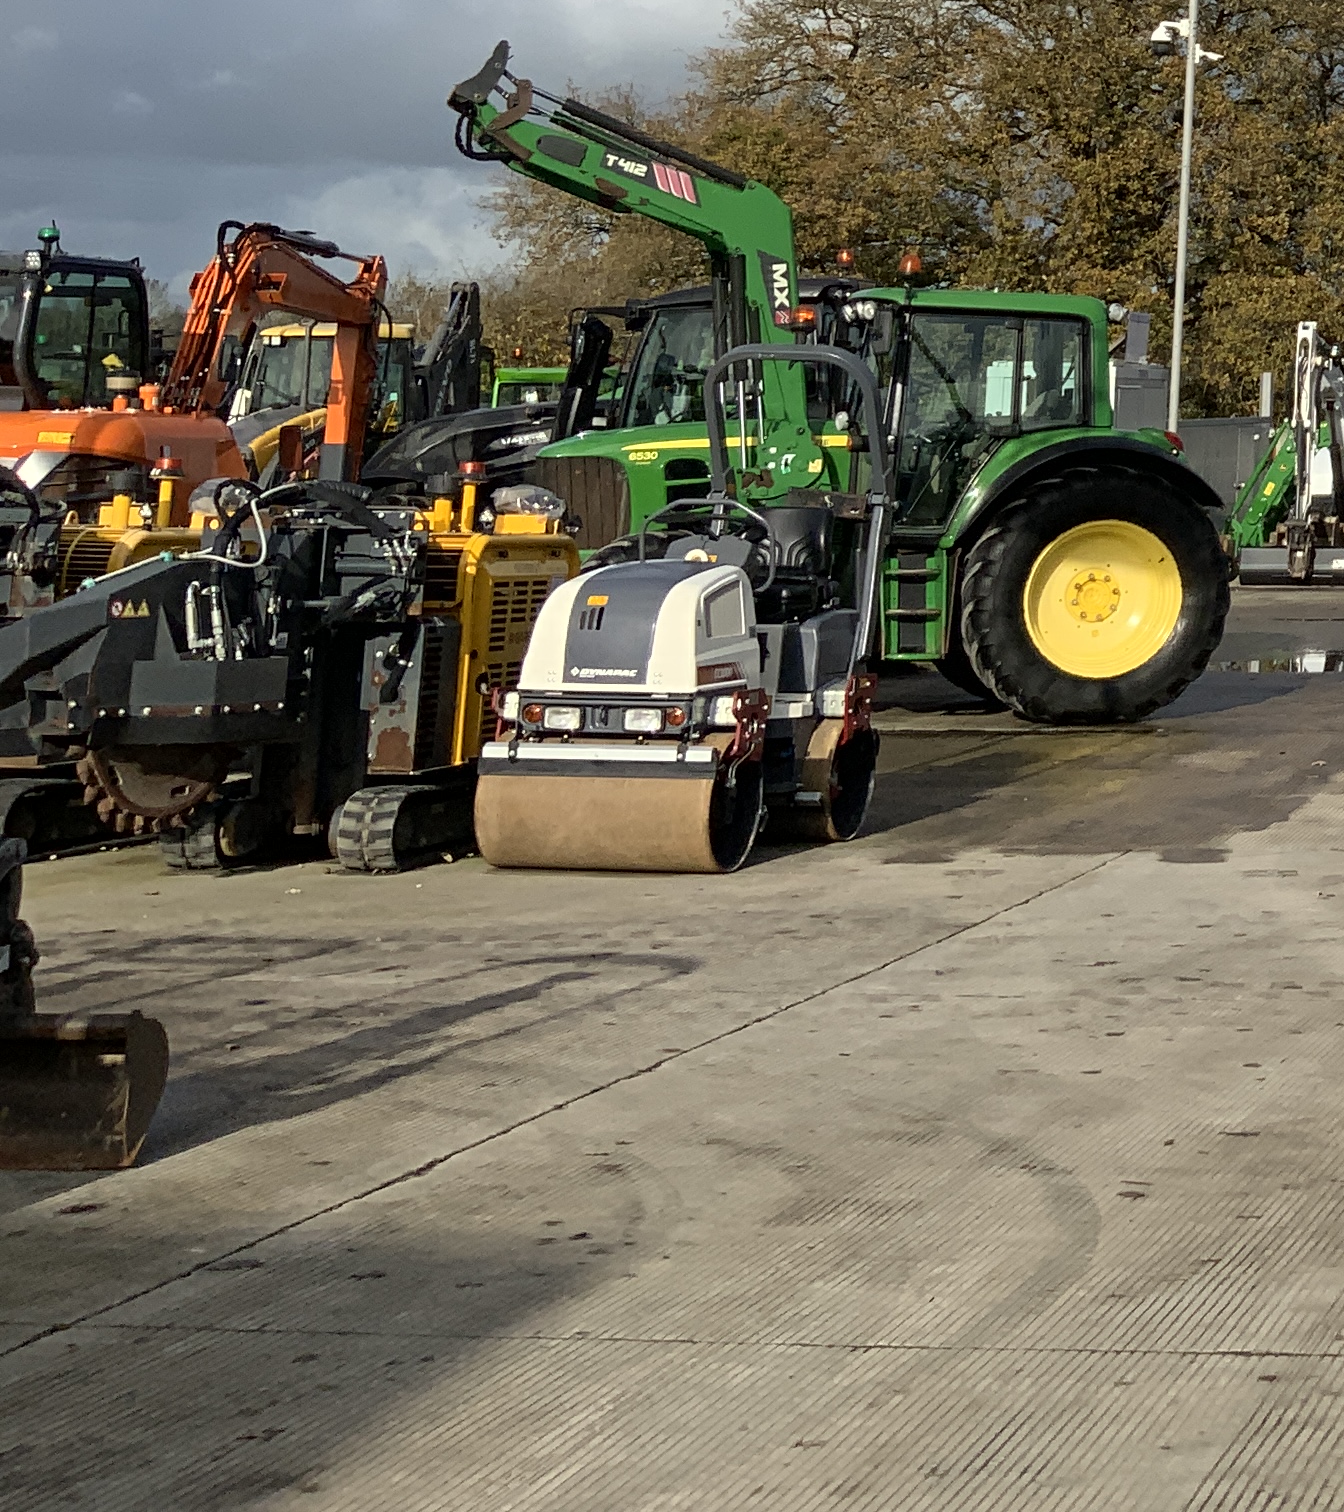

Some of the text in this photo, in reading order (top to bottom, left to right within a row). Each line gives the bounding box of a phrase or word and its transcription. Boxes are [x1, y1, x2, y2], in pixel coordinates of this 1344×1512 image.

[605, 153, 648, 178] T412
[772, 263, 790, 309] MX
[628, 451, 659, 461] 6530
[580, 667, 639, 677] DYNAPAC
